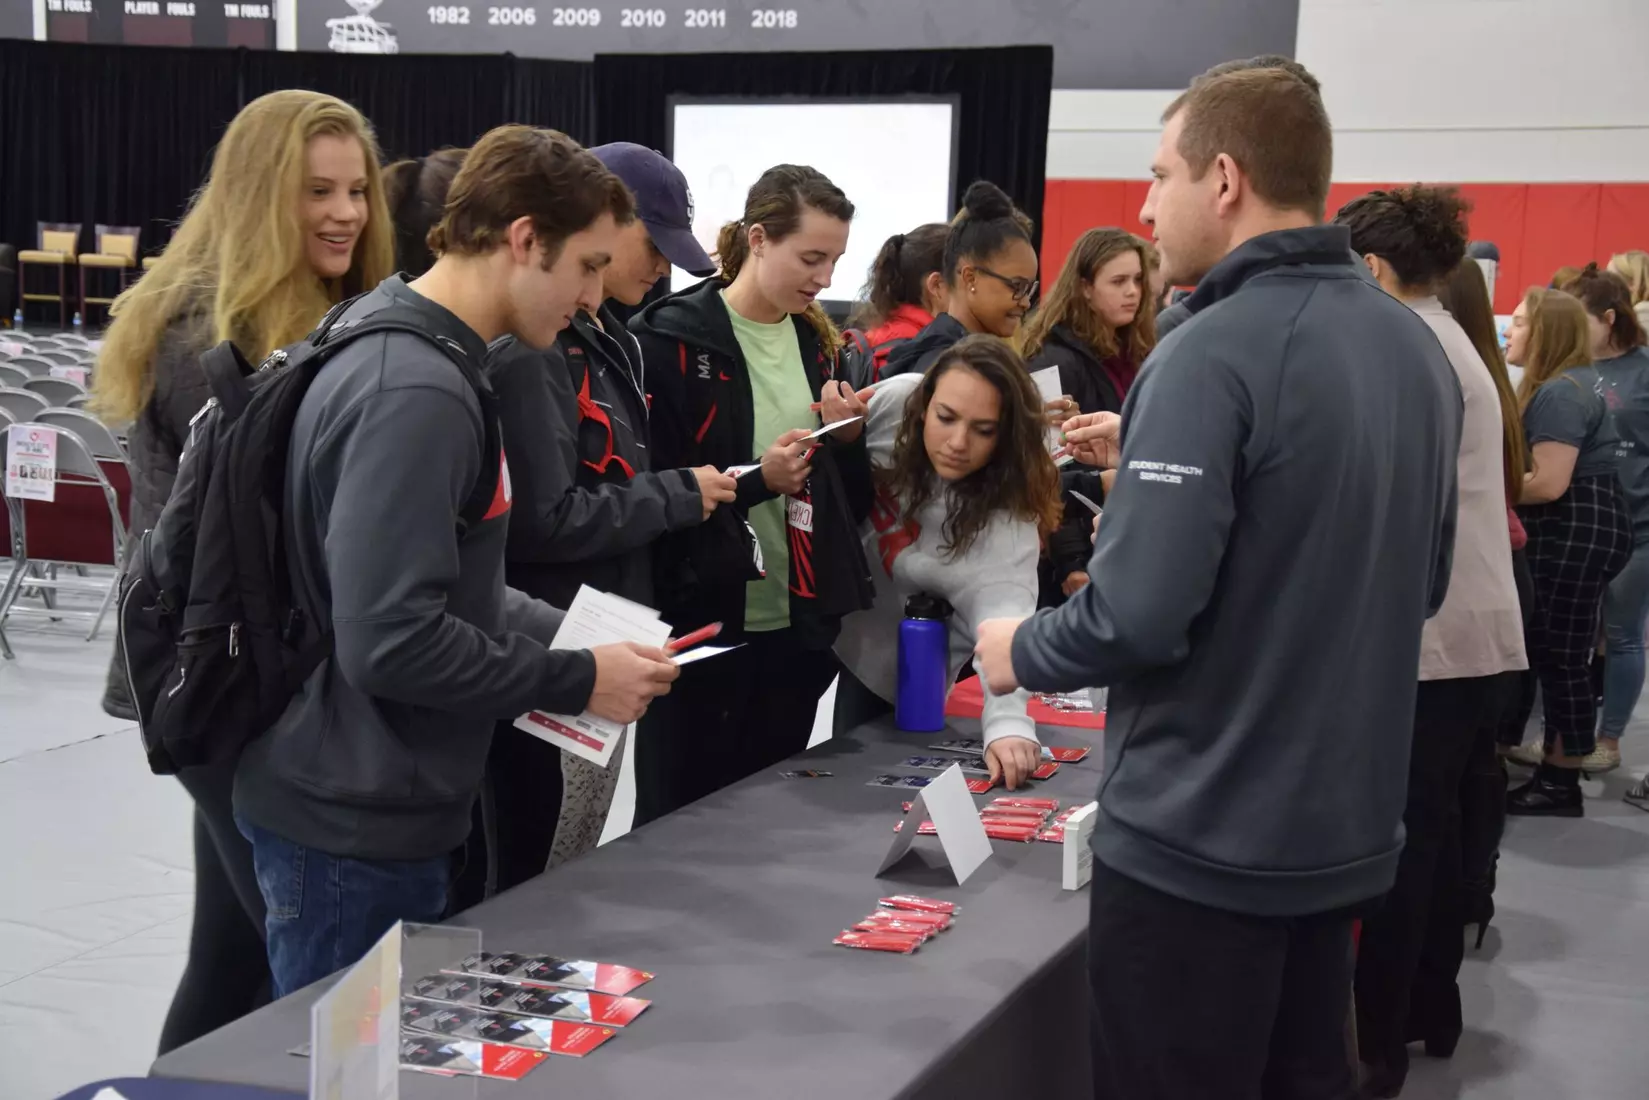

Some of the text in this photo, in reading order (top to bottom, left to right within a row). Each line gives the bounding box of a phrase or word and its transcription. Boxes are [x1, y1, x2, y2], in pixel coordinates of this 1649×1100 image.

[47, 0, 93, 13] TM FOULS
[124, 0, 196, 16] PLAYER FOULS
[223, 3, 270, 19] TM FOULS
[427, 5, 798, 29] 1982 2006 2009 2010 2011 2018
[696, 350, 711, 379] MA
[1128, 460, 1203, 476] STUDENT HEALTH
[1138, 471, 1182, 484] SERVICES
